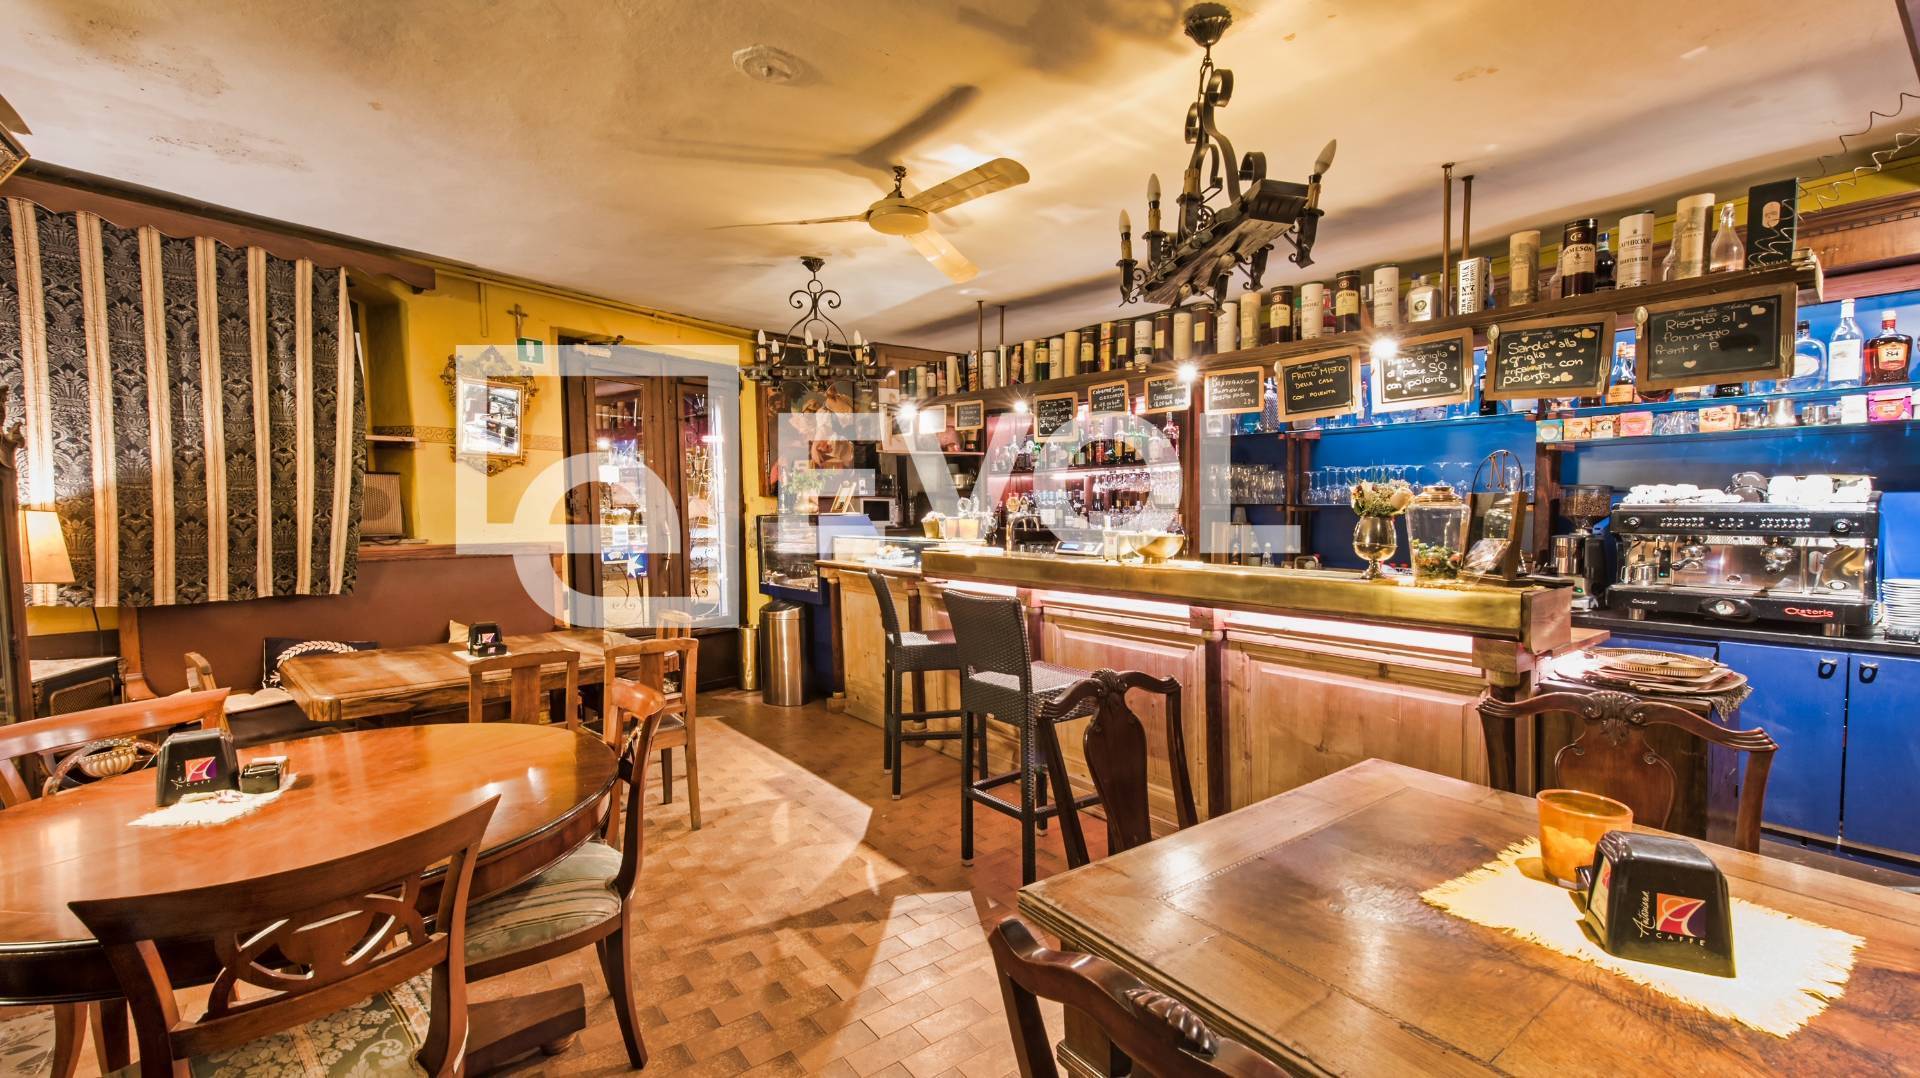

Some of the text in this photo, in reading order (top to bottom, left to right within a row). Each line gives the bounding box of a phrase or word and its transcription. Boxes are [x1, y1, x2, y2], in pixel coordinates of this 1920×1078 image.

[1665, 316, 1716, 332] Risotto
[1722, 311, 1736, 322] al
[1663, 328, 1730, 343] formaggio
[1508, 338, 1577, 355] Sarde alla
[1509, 351, 1546, 368] griglia
[1559, 359, 1584, 367] con
[1291, 365, 1346, 381] FRITTO MISTO
[1502, 371, 1551, 388] polenta
[1406, 375, 1448, 390] polenta
